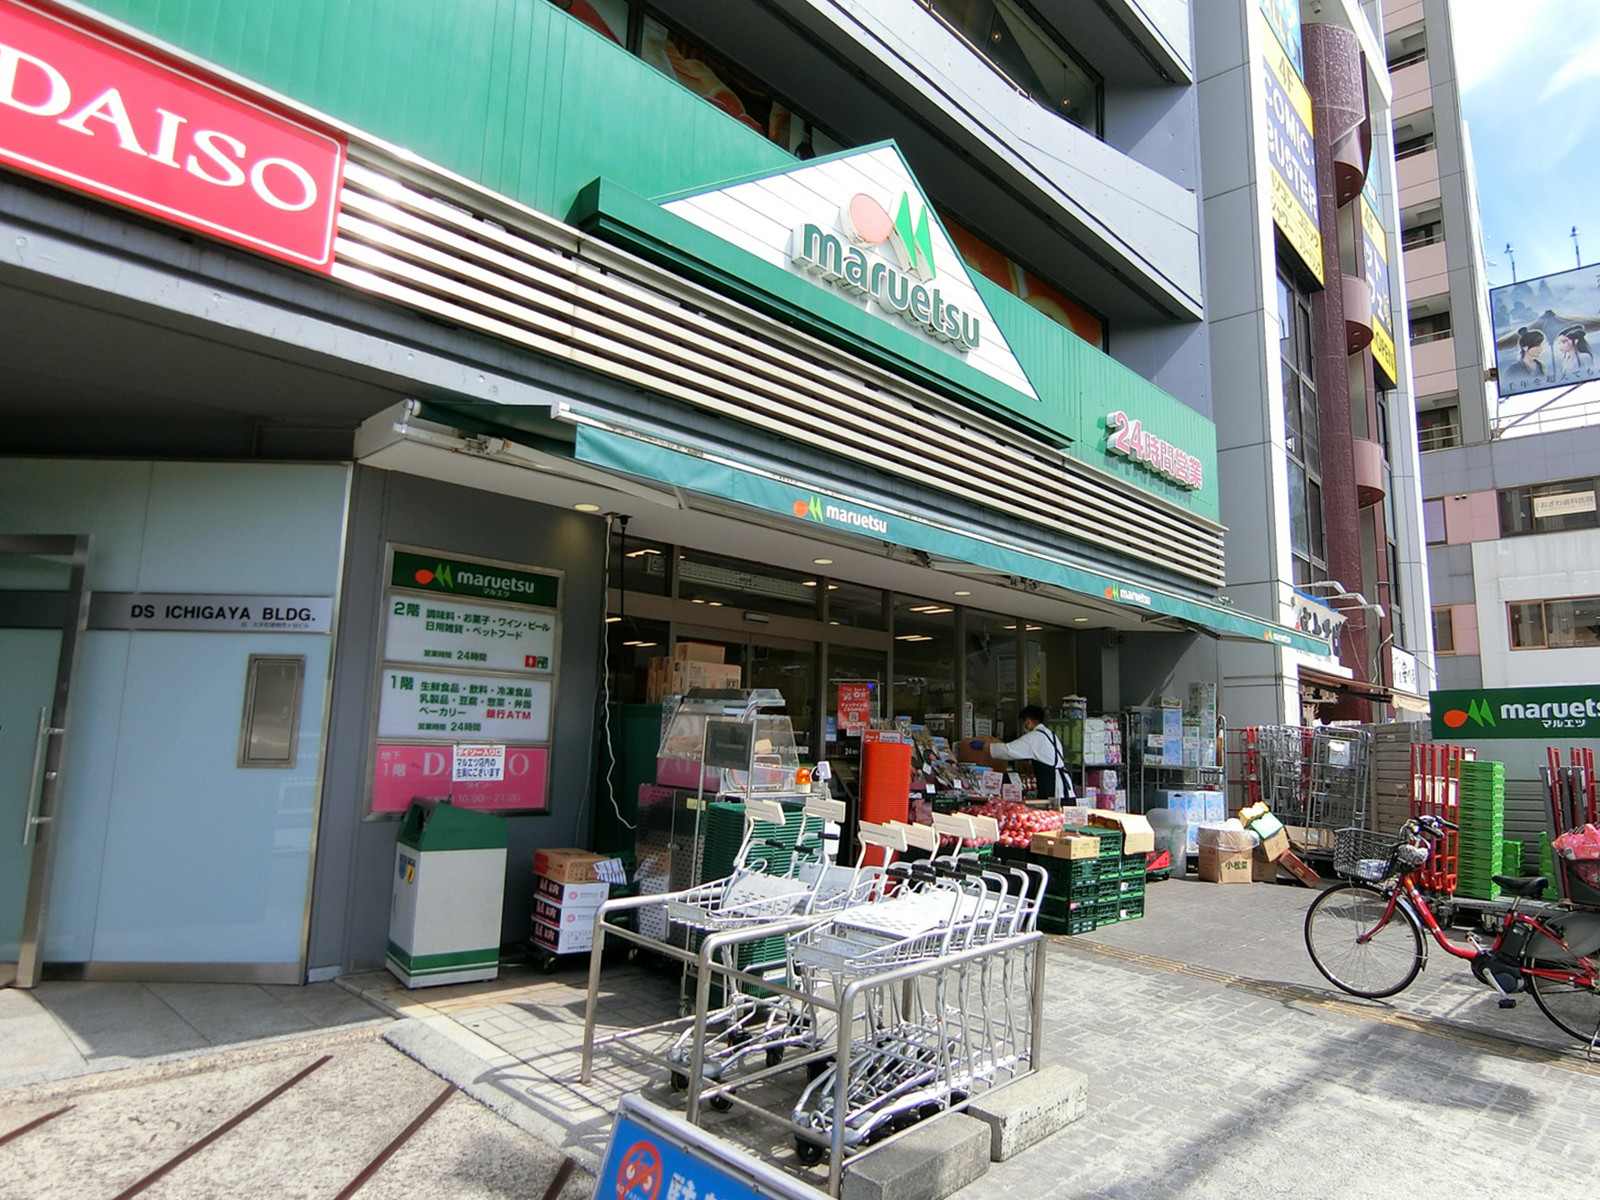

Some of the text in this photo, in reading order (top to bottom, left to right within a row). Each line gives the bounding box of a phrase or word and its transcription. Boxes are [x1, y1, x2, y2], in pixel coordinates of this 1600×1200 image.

[0, 44, 318, 212] DAISO
[800, 221, 981, 351] maruetsu
[1106, 410, 1203, 491] 24時間営業
[826, 504, 888, 533] maruetsu
[456, 571, 535, 594] maruetsu
[131, 604, 316, 622] DS ICHIGAYA BLDG.
[394, 602, 420, 618] 2階
[457, 650, 488, 662] 24時間
[390, 675, 414, 691] 1階
[419, 706, 532, 720] ベーカリー 銀行ATM
[451, 721, 482, 732] 24時間
[1541, 718, 1587, 729] マルエツ
[1225, 861, 1248, 870] 小松菜
